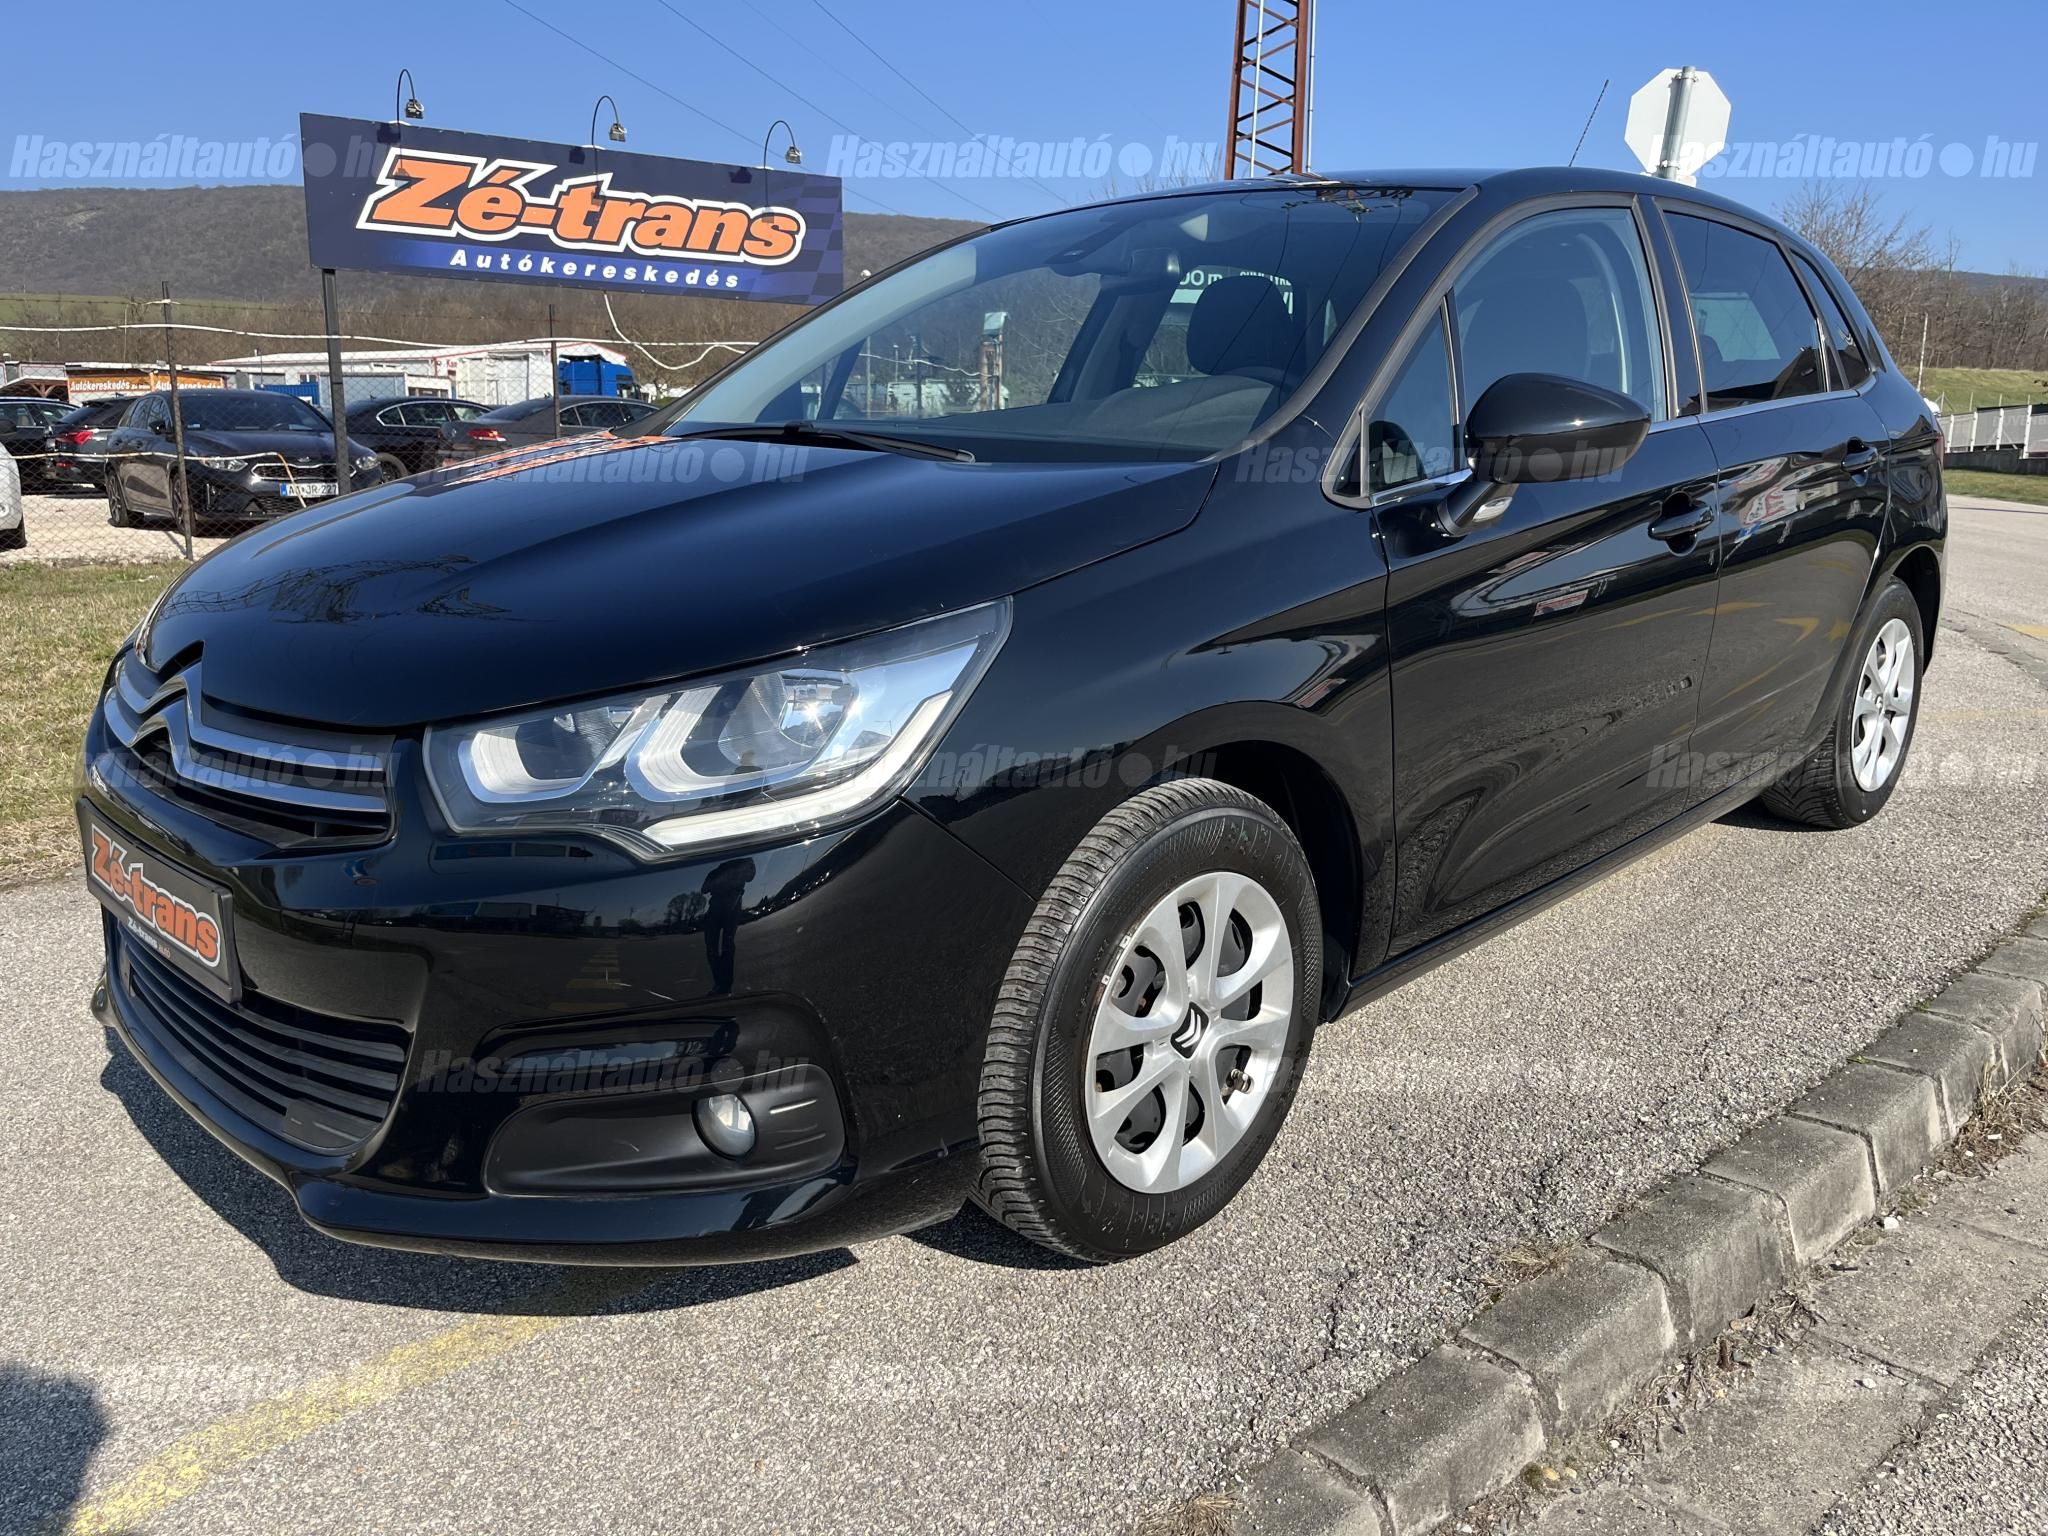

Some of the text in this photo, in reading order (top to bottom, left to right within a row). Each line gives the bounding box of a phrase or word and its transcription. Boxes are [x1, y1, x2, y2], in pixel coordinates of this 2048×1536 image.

[360, 151, 805, 263] Zé-trans
[449, 247, 739, 288] Autókereskedés
[92, 826, 220, 965] Zé-trans
